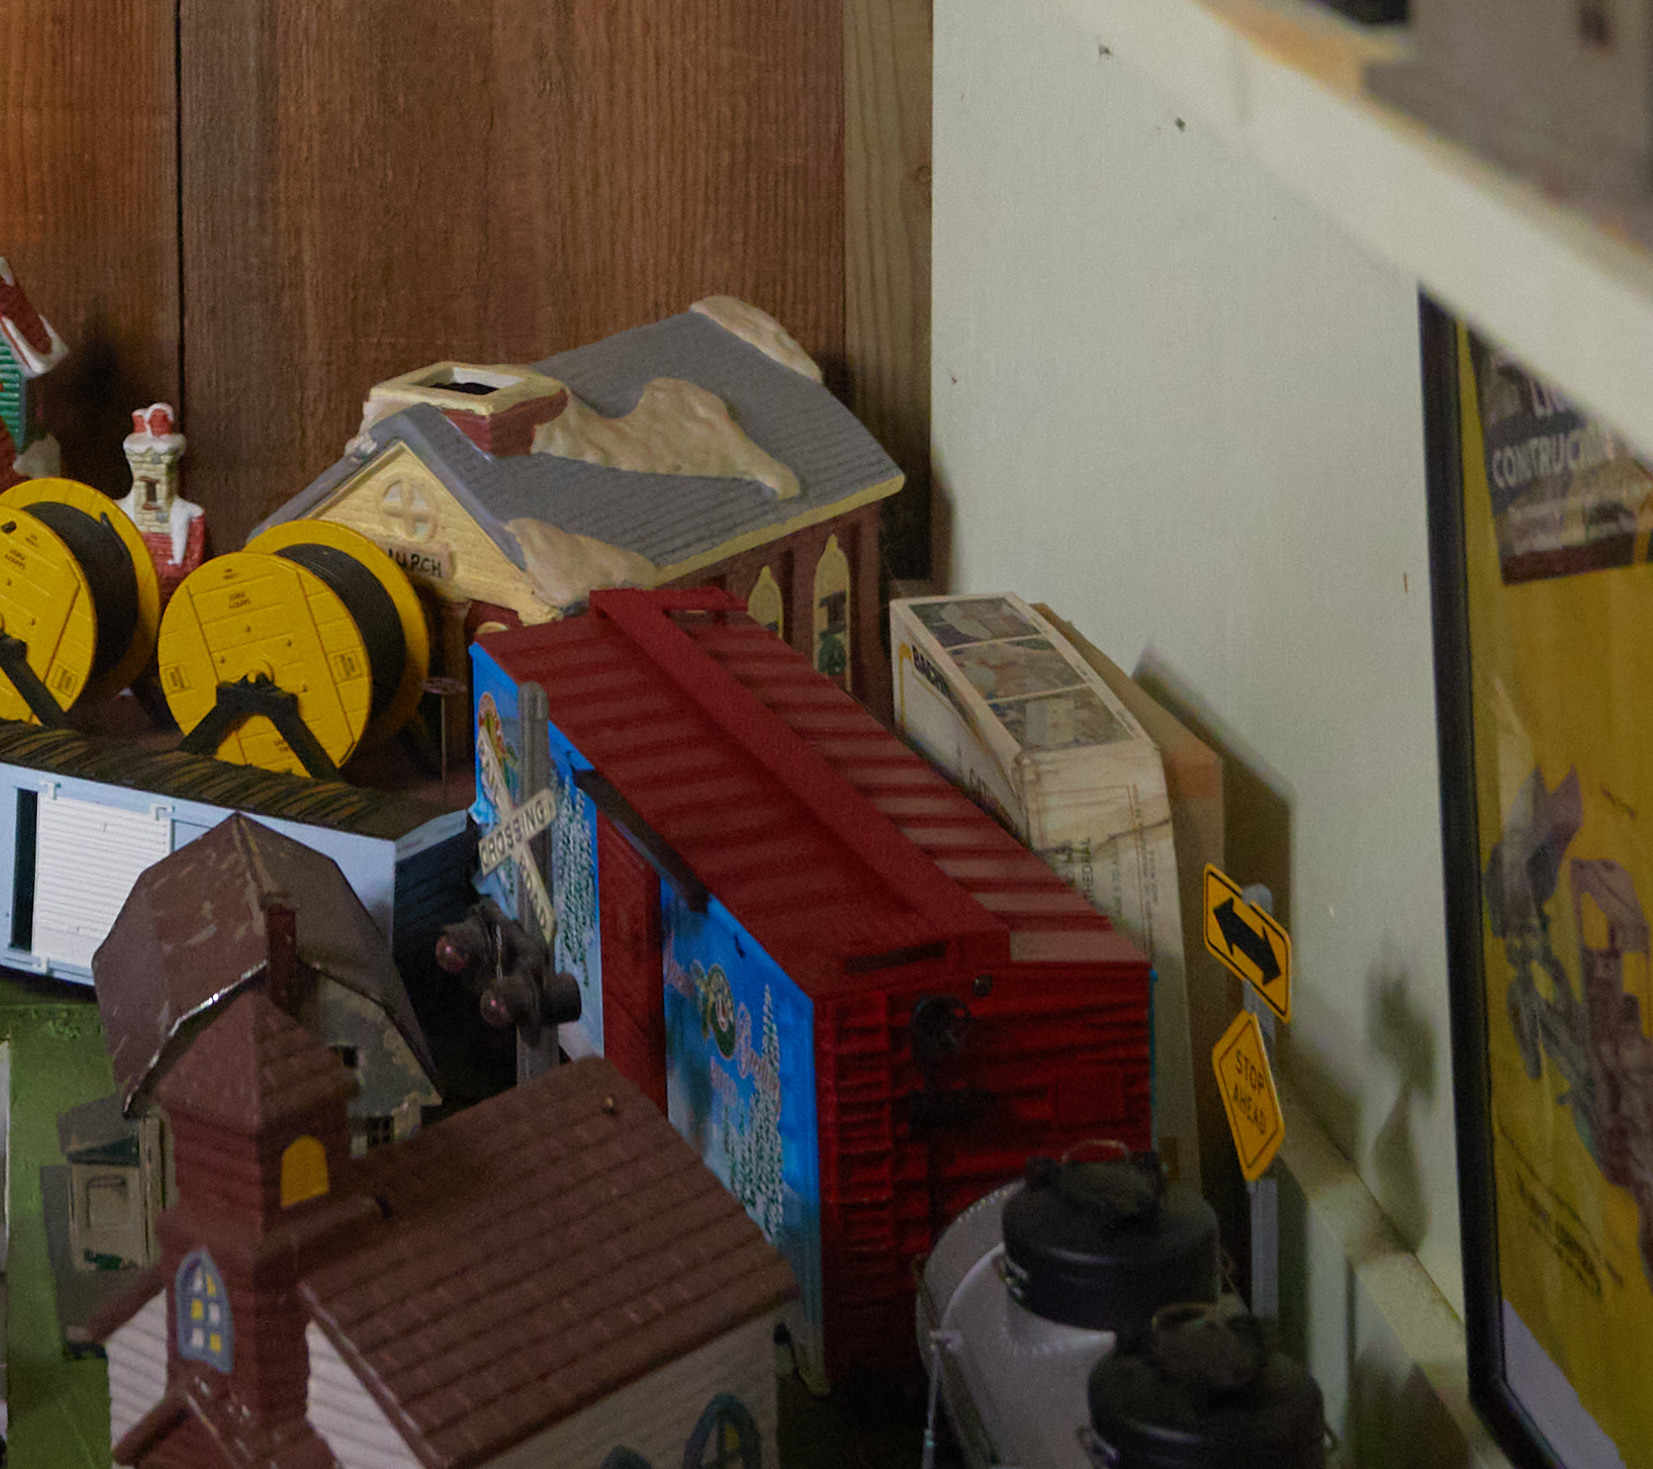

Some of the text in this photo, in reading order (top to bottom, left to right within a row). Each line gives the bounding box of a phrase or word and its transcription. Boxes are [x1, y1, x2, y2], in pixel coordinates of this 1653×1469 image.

[479, 806, 547, 866] CROSSING
[1234, 1049, 1267, 1092] STOP
[1232, 1082, 1267, 1136] AHEAD
